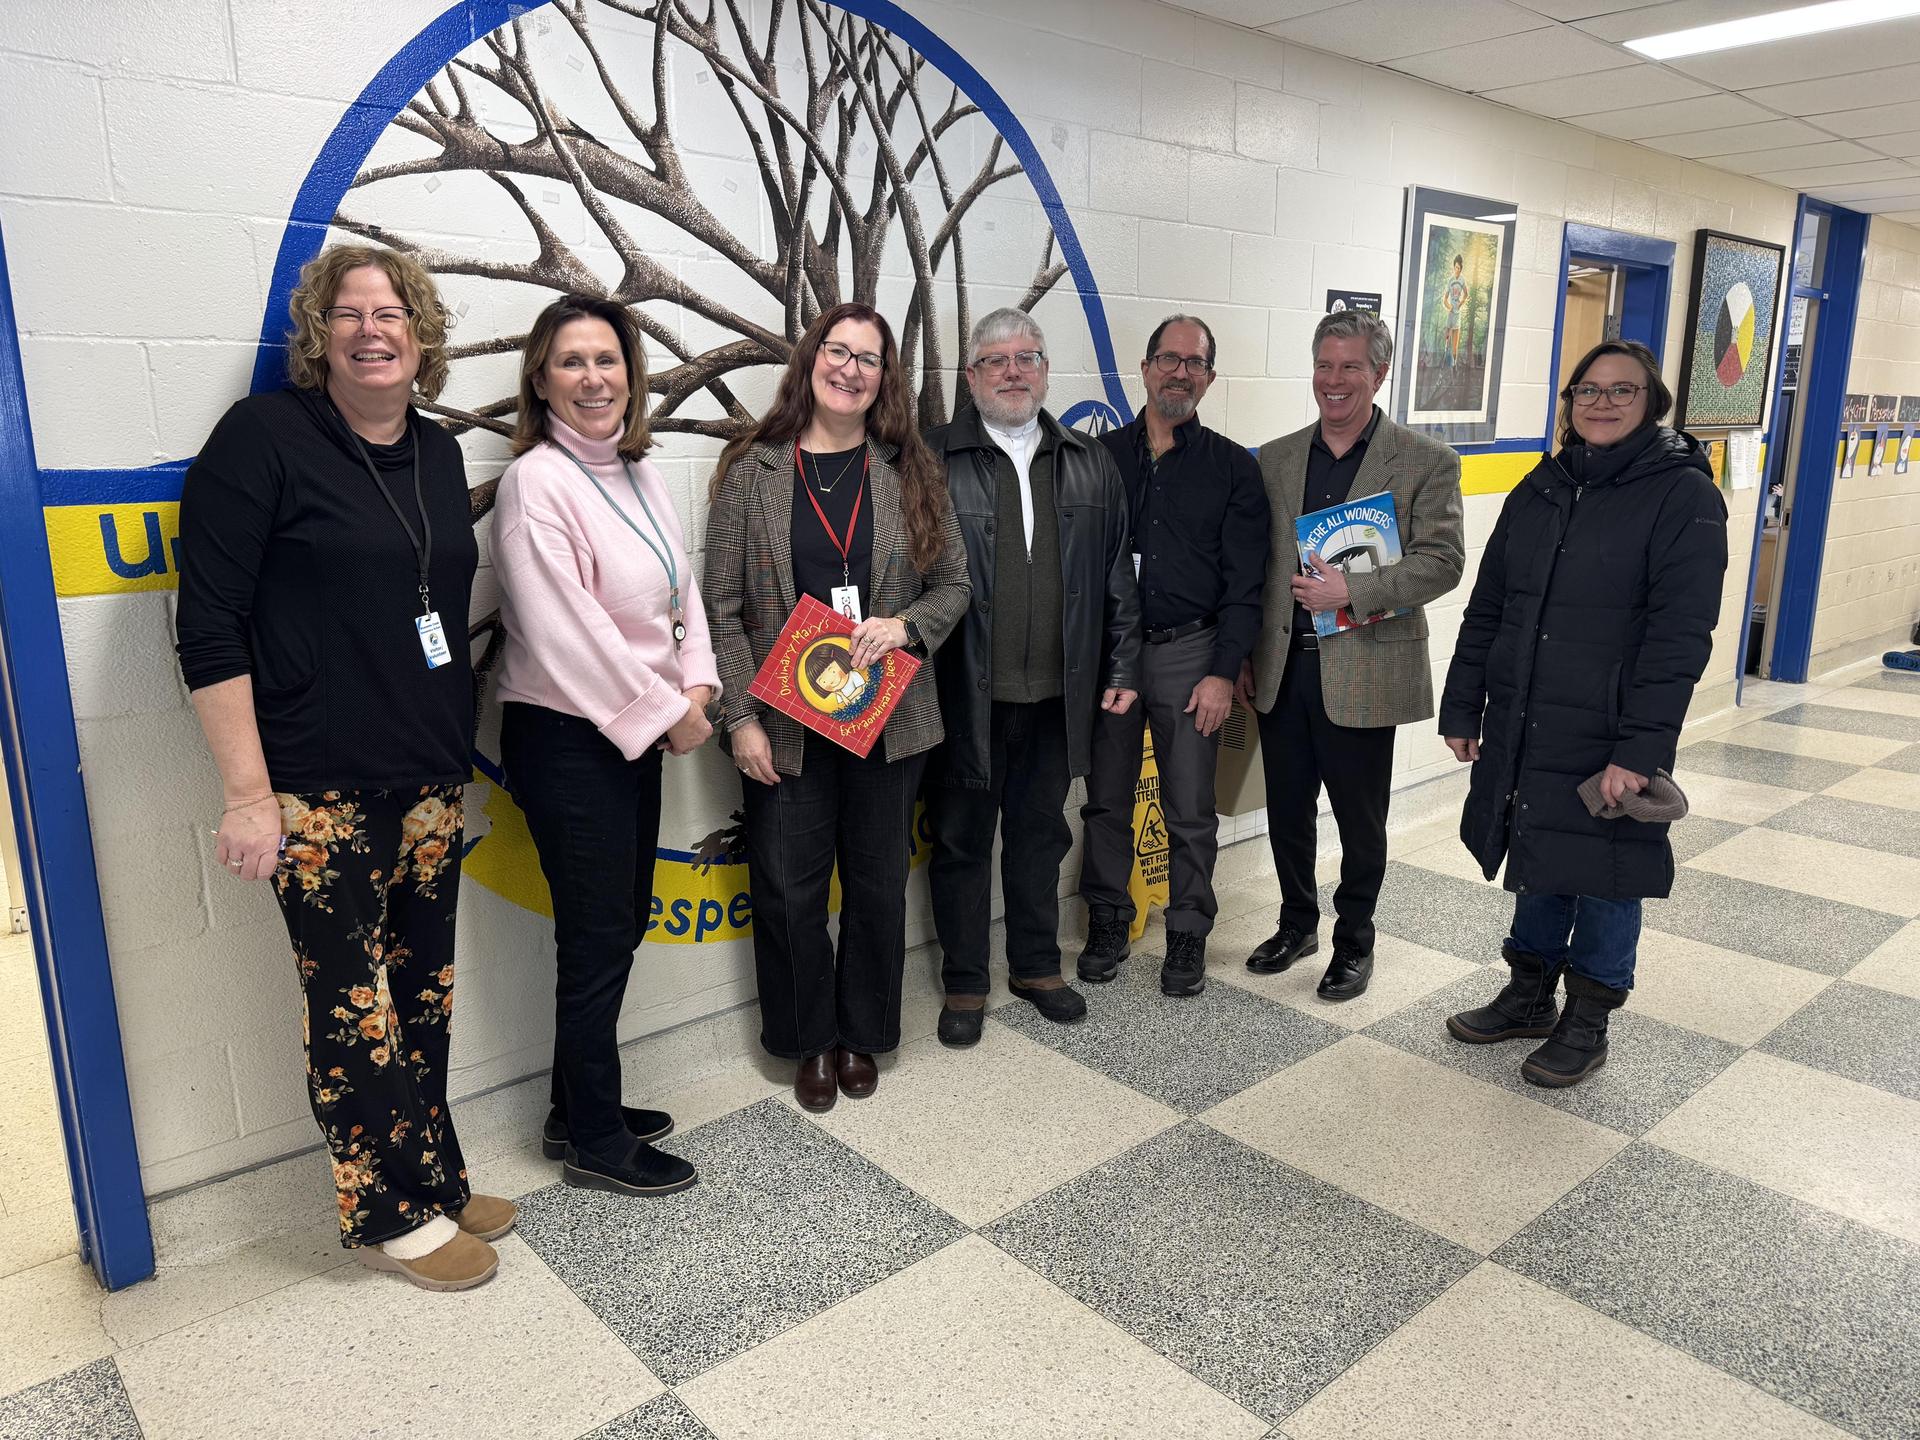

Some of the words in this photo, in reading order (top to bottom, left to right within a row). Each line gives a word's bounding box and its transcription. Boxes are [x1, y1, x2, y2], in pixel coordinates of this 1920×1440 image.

[1304, 522, 1328, 551] WE'RE
[1326, 513, 1345, 530] ALL
[1344, 507, 1394, 529] WONDERS
[776, 644, 797, 696] Ordinary
[791, 618, 830, 644] Mary's
[840, 681, 897, 737] Extraordinary
[1140, 856, 1154, 867] WET
[1155, 852, 1169, 863] FLO
[1142, 863, 1169, 877] PLANCH
[1146, 872, 1169, 886] MOUIL
[645, 891, 752, 942] espe
